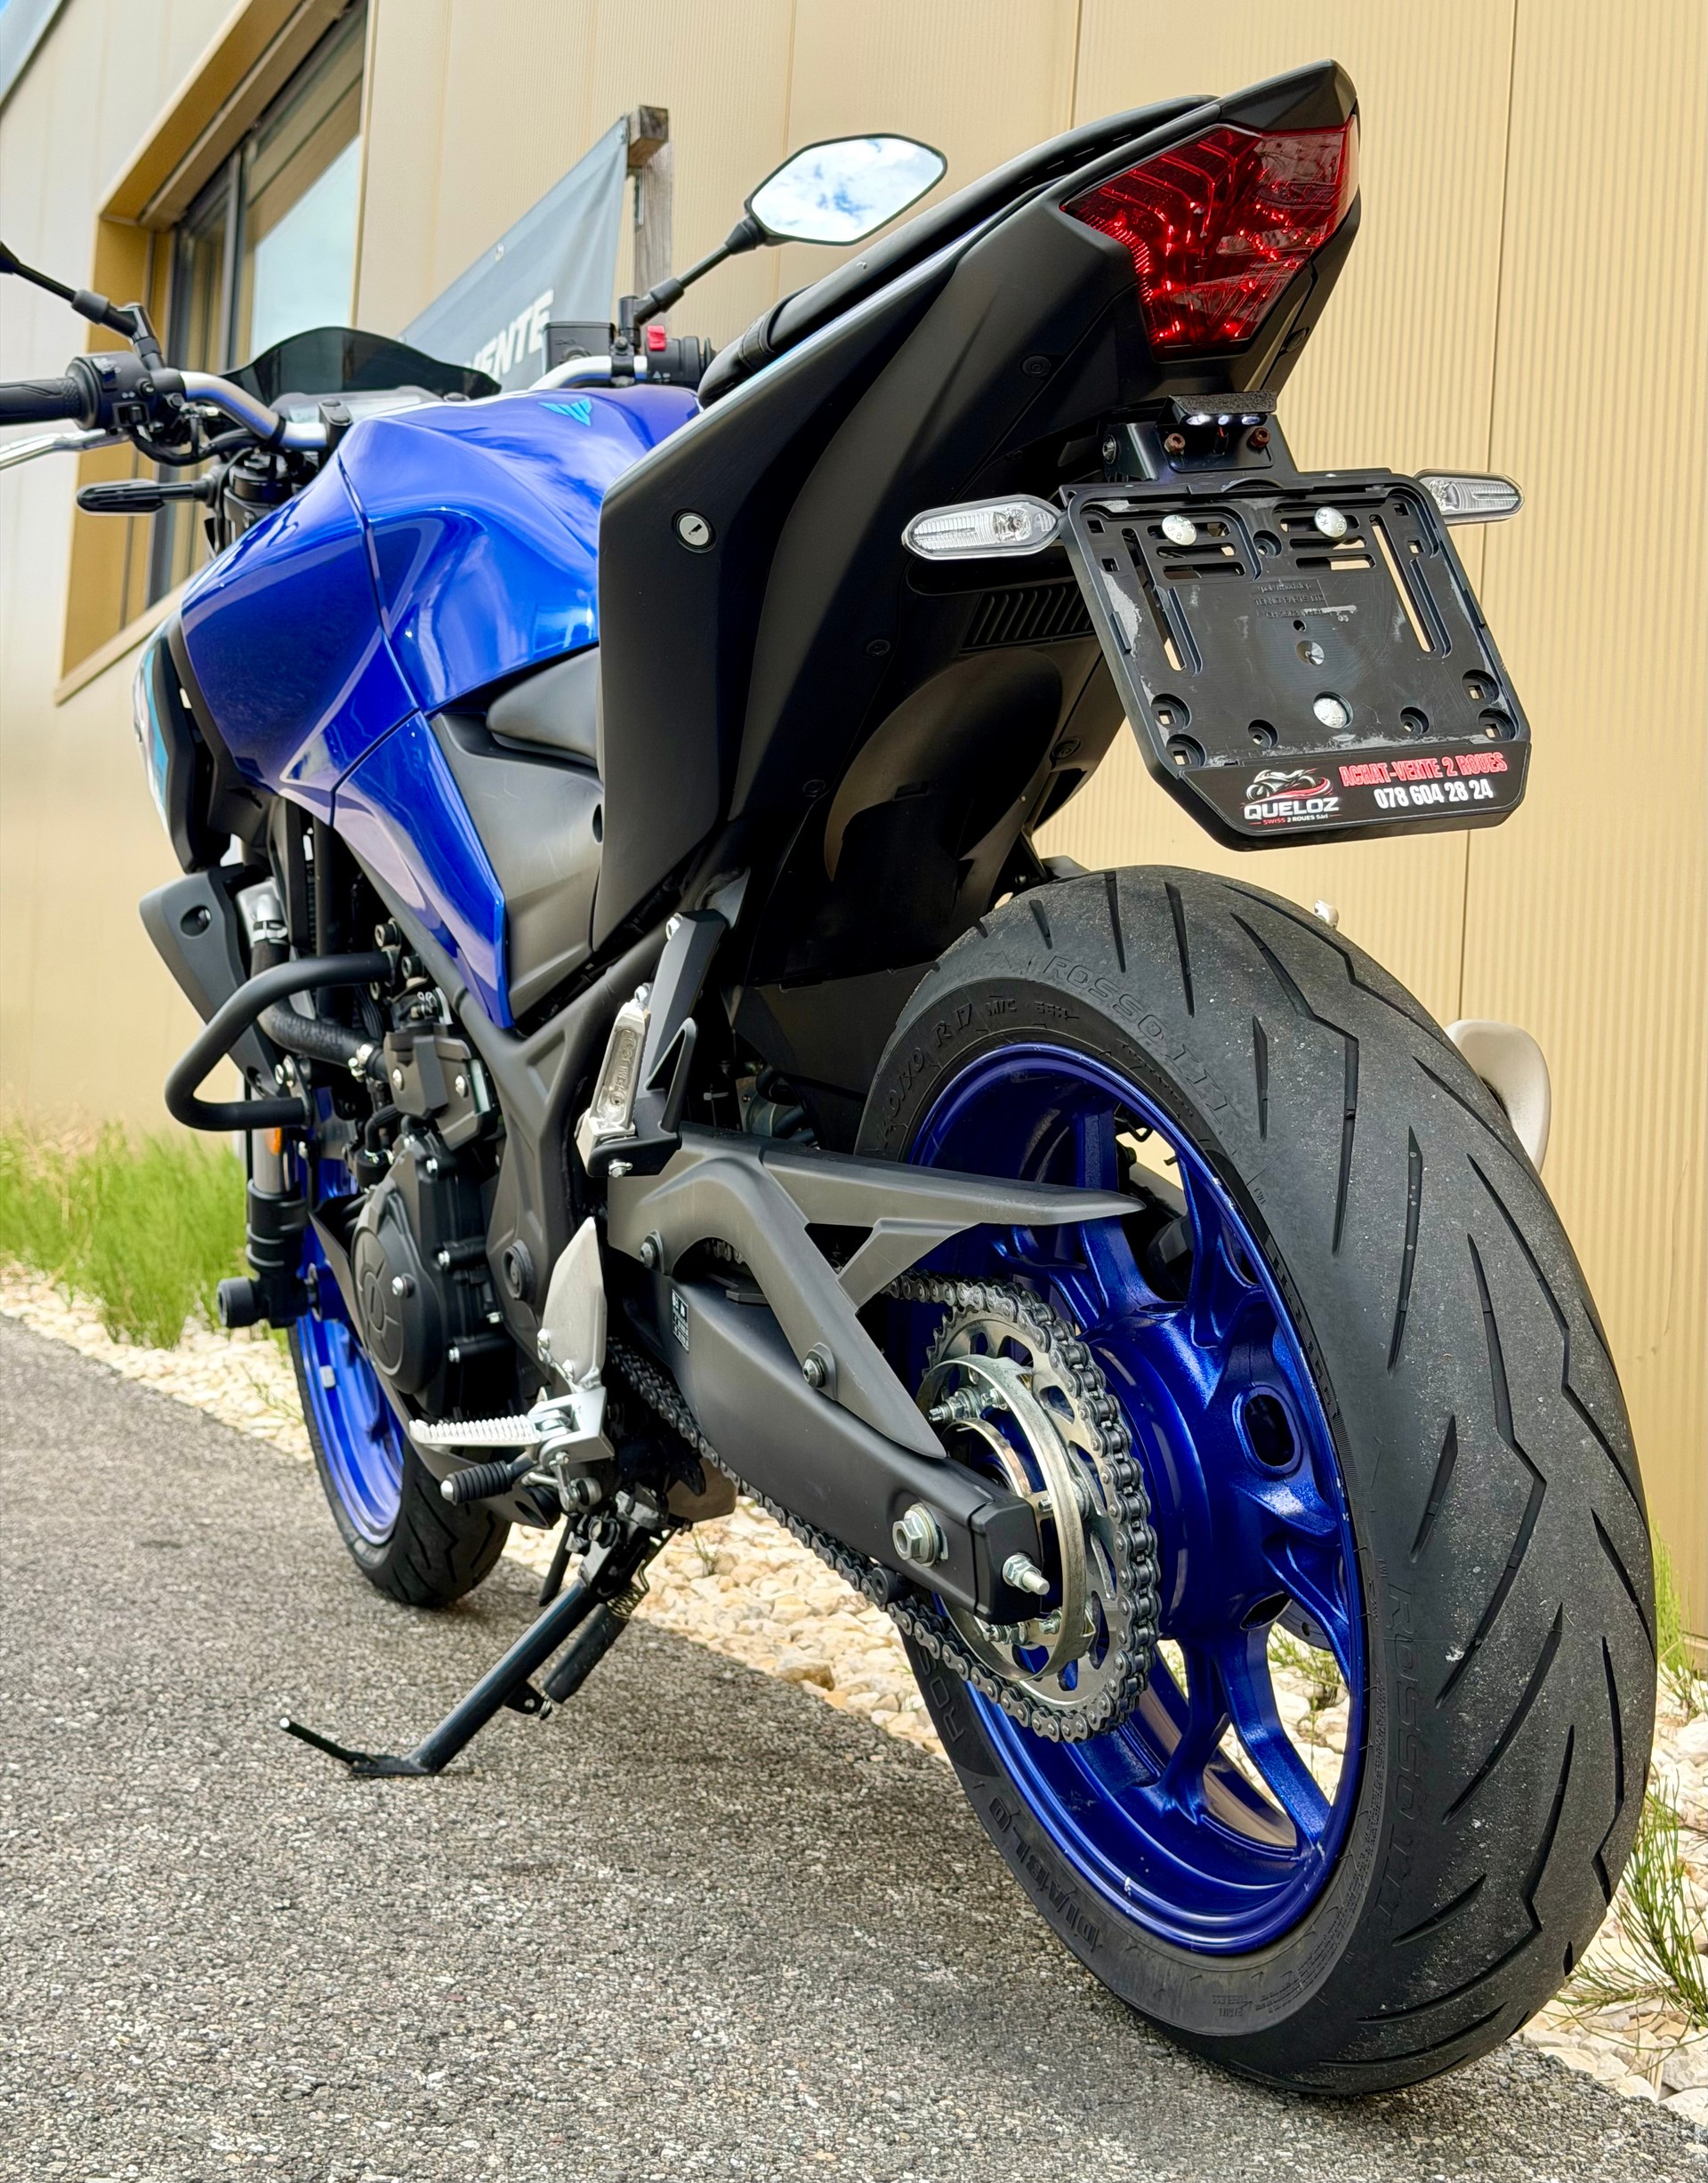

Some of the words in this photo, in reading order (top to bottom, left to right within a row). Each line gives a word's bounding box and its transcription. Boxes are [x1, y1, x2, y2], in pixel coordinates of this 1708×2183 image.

[1339, 758, 1443, 786] ACHAT-VENTE
[1441, 756, 1458, 777] 2
[1455, 752, 1508, 776] ROUES
[1244, 797, 1339, 820] QUELOZ
[1374, 786, 1409, 809] 078
[1409, 784, 1445, 805] 604
[1444, 781, 1468, 802] 28
[1469, 778, 1494, 800] 24
[1263, 818, 1286, 826] SWISS
[987, 1795, 1101, 1953] DIABLO
